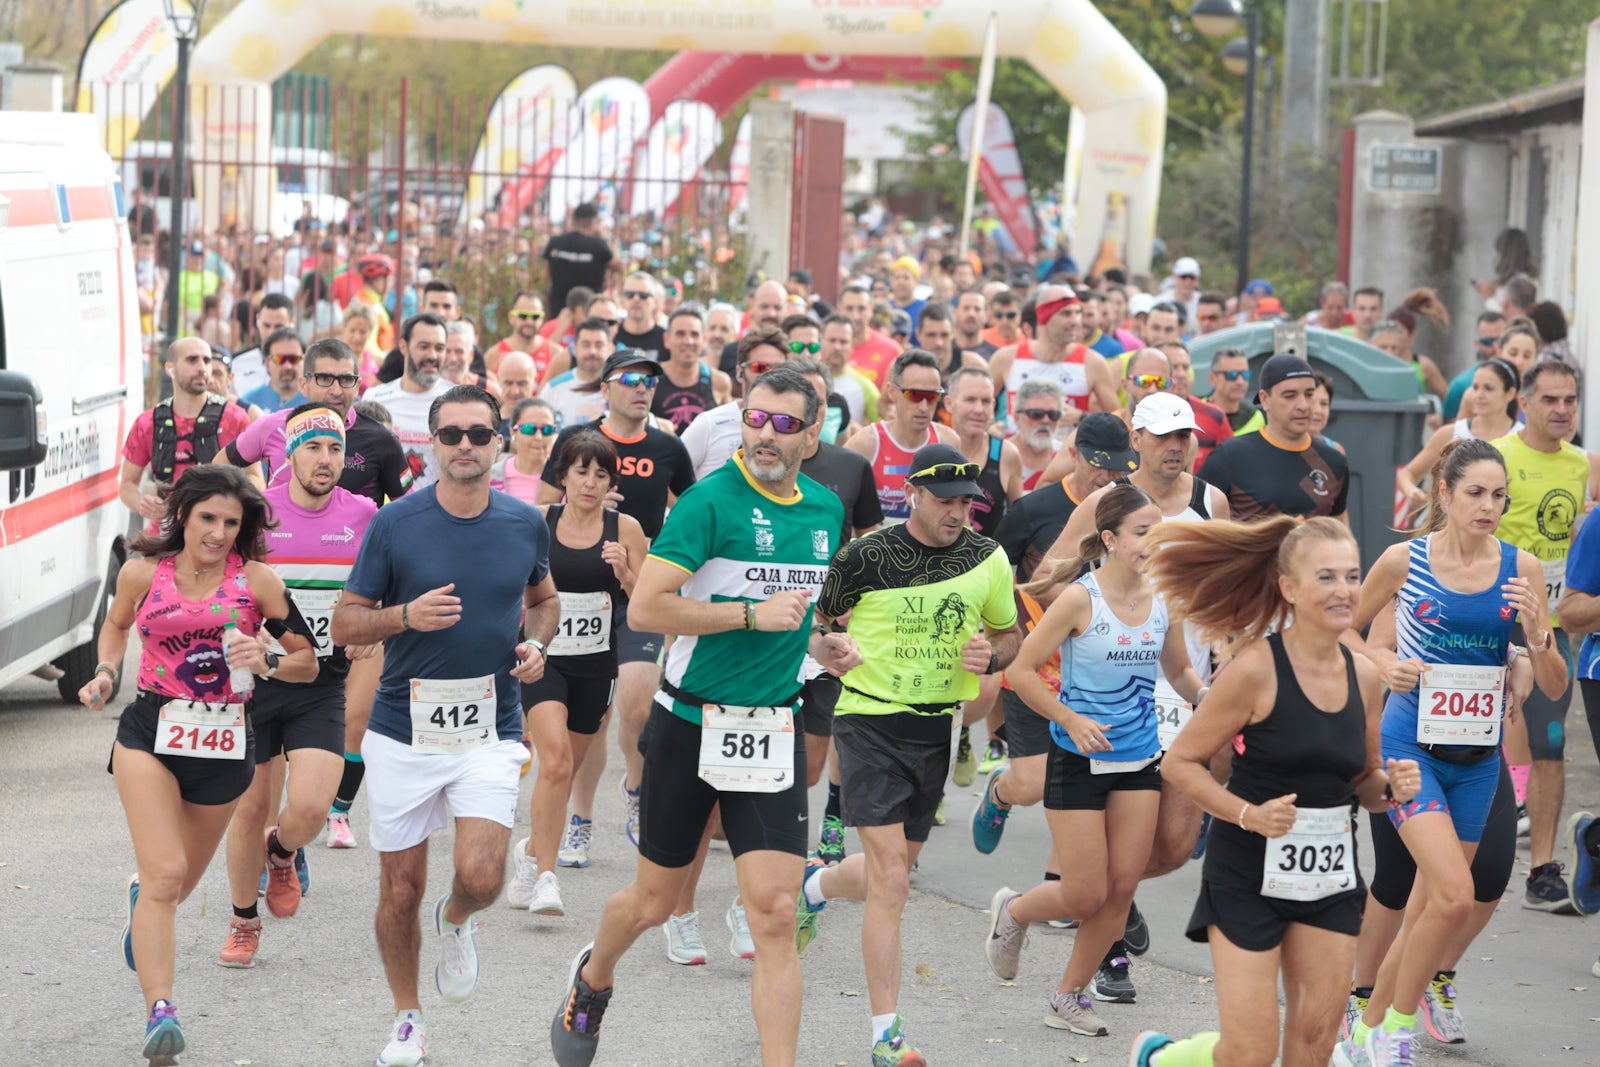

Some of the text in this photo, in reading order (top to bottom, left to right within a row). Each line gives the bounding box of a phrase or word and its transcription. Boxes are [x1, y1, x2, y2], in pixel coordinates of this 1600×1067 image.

[616, 456, 654, 477] SO
[745, 567, 828, 585] CAJA RURA
[902, 596, 924, 614] XI
[896, 615, 928, 624] Prueba
[895, 625, 928, 634] Fondo
[896, 637, 920, 646] VILLA
[1419, 633, 1500, 650] SONRIALIA
[1431, 691, 1494, 717] 2043
[430, 704, 479, 728] 412
[167, 725, 235, 752] 2148
[721, 733, 770, 760] 581
[1278, 844, 1345, 873] 3032
